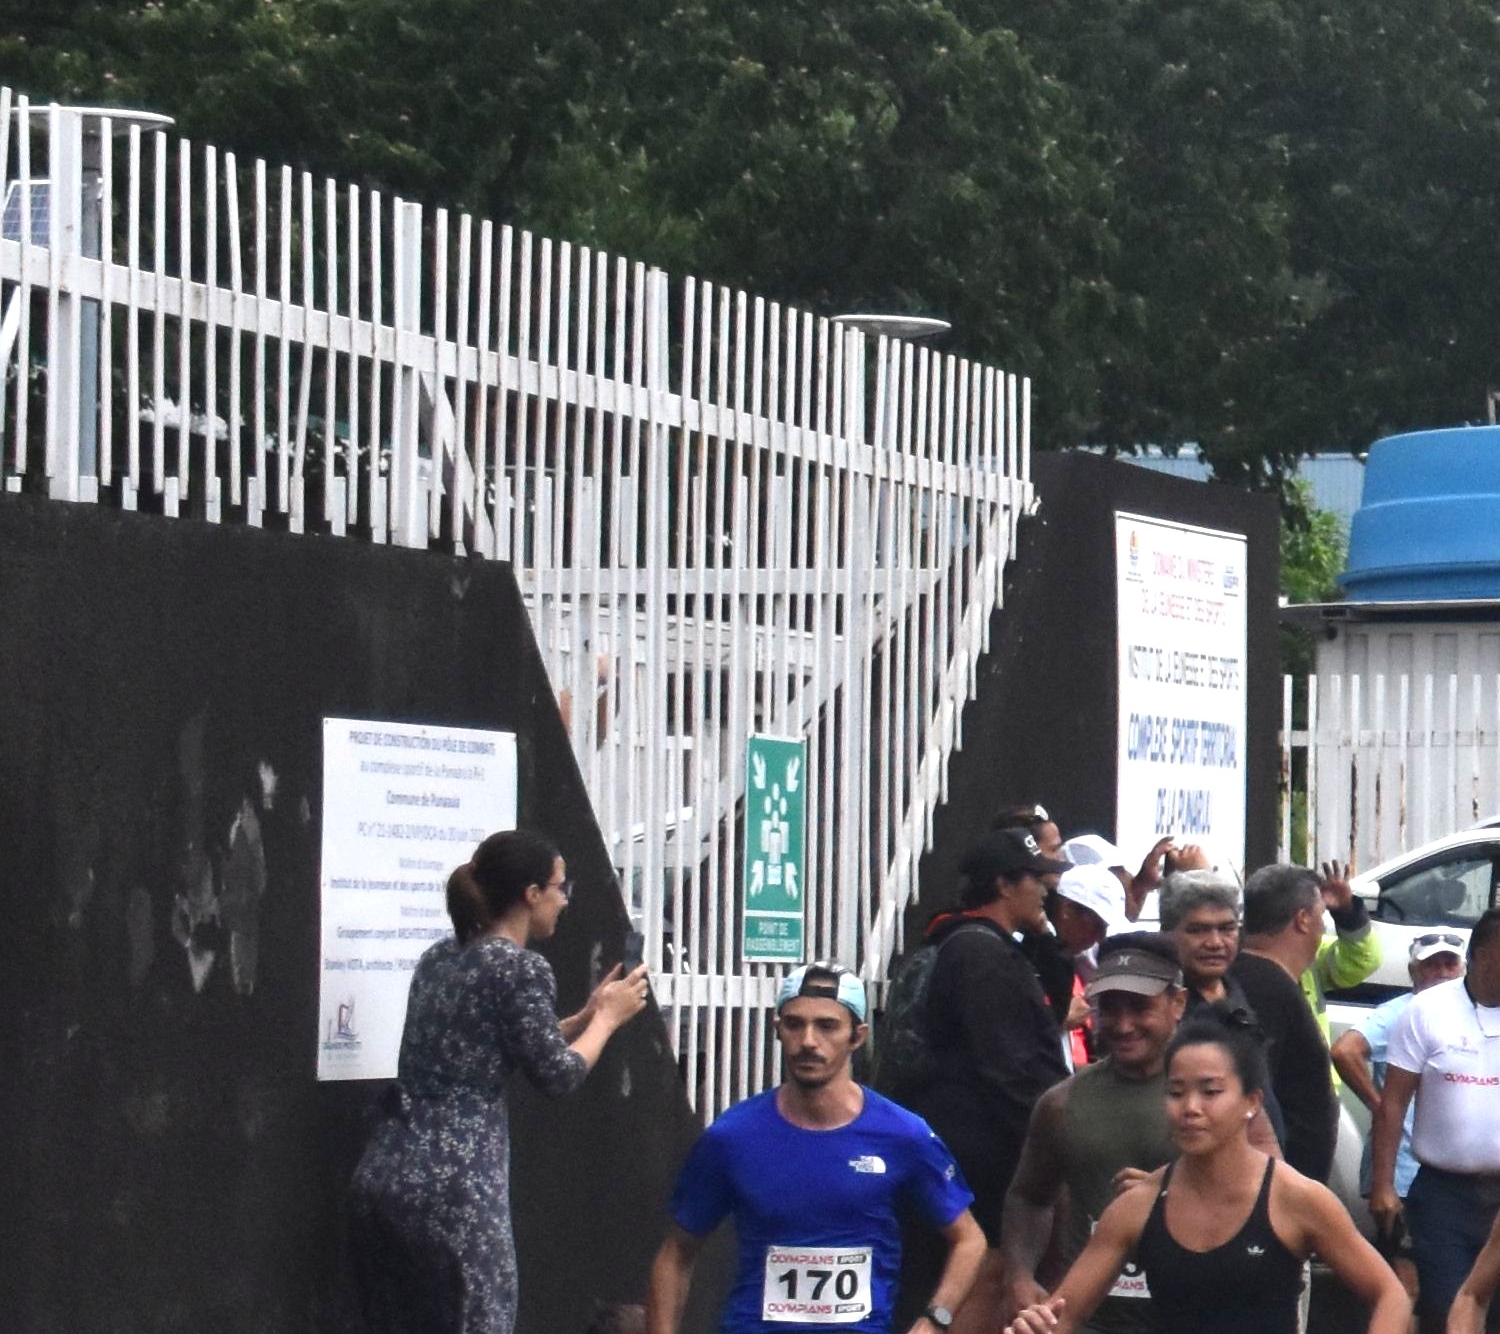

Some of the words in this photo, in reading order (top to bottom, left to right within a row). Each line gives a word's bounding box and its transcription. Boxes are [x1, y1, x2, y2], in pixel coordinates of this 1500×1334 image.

[1445, 1072, 1500, 1085] OLYMPIANS
[770, 1254, 834, 1265] OLYMPIANS
[779, 1269, 858, 1300] 170
[767, 1302, 831, 1314] OLYMPIANS
